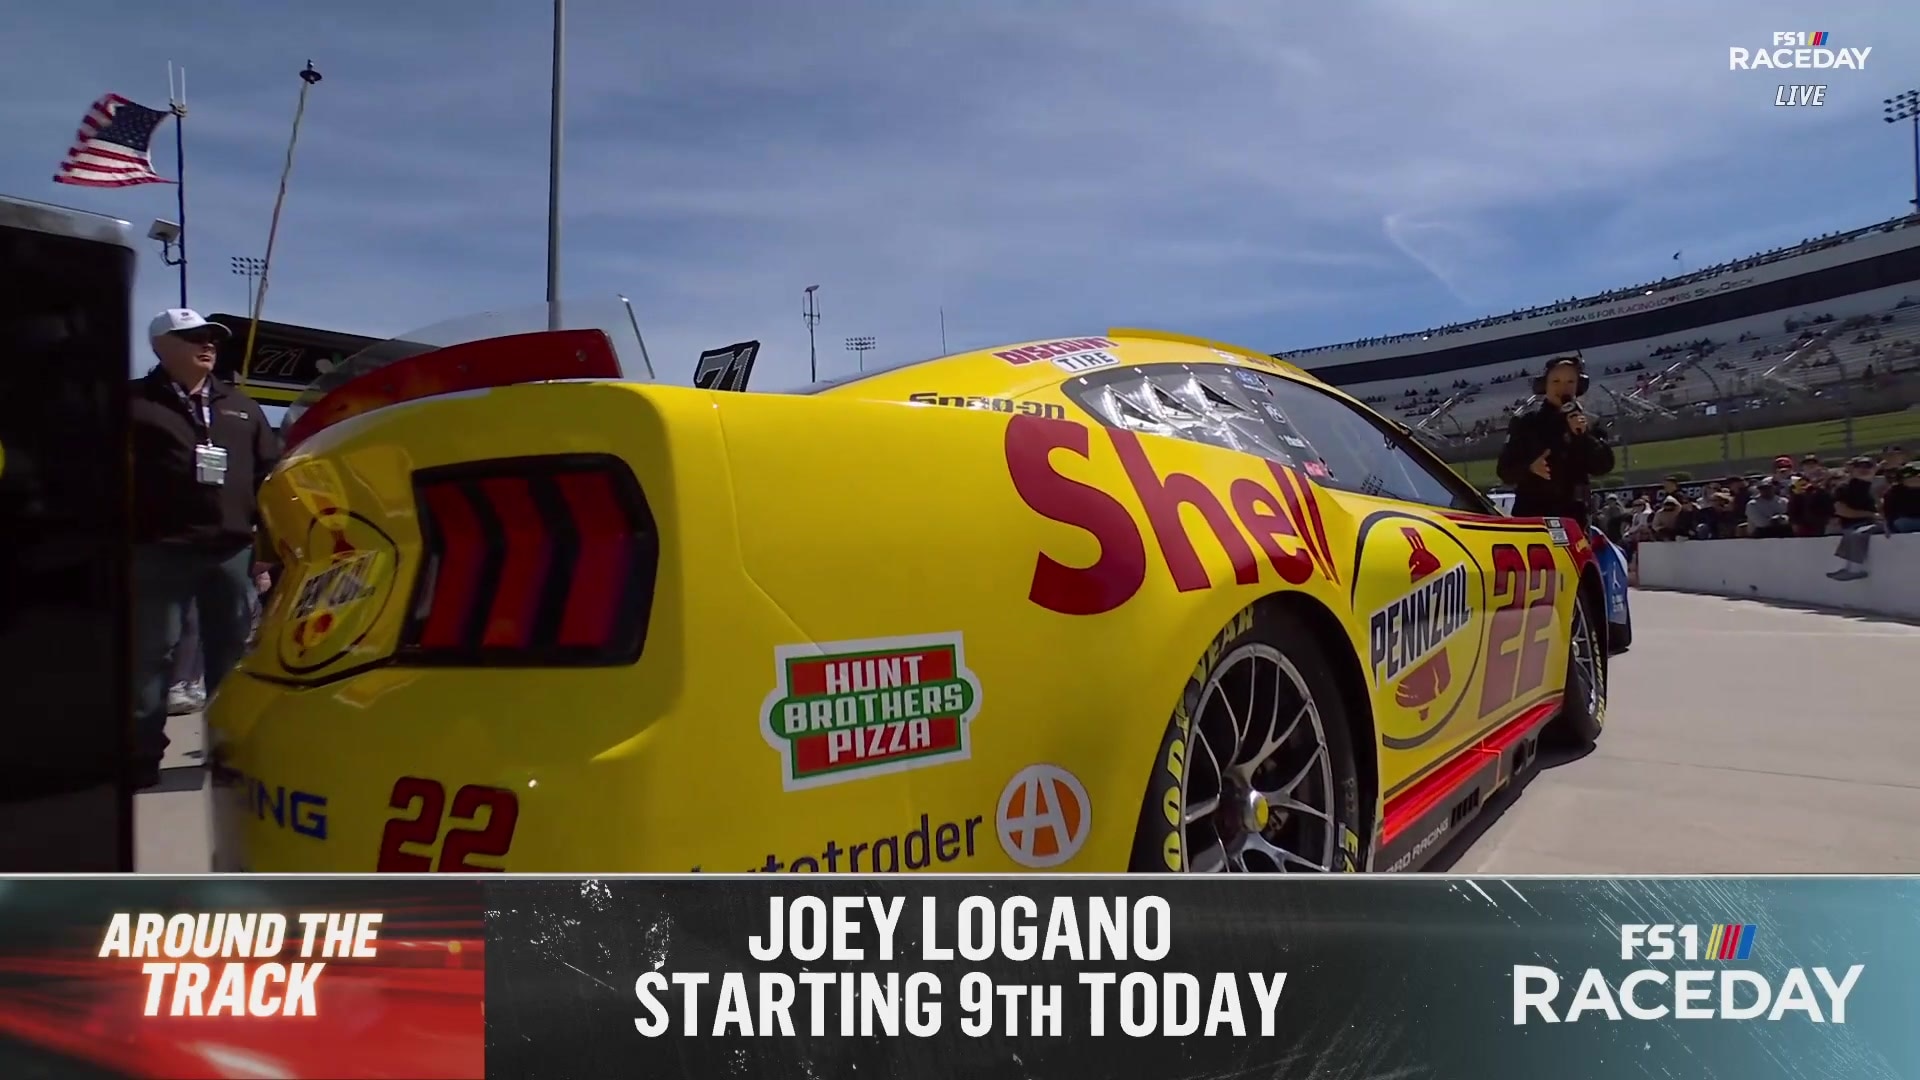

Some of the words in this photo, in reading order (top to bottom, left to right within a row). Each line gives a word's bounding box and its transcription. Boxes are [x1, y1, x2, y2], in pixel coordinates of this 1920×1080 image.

[253, 344, 307, 377] 71
[695, 346, 754, 392] 71
[1056, 352, 1114, 370] TIRE
[1004, 414, 1342, 617] Shell
[1370, 563, 1473, 688] PENNZOIL
[1477, 543, 1557, 720] 22
[824, 655, 924, 695] HUNT
[783, 683, 964, 735] BROTHERS
[827, 717, 932, 764] PIZZA
[376, 775, 520, 873] 22
[1411, 816, 1450, 859] RACING
